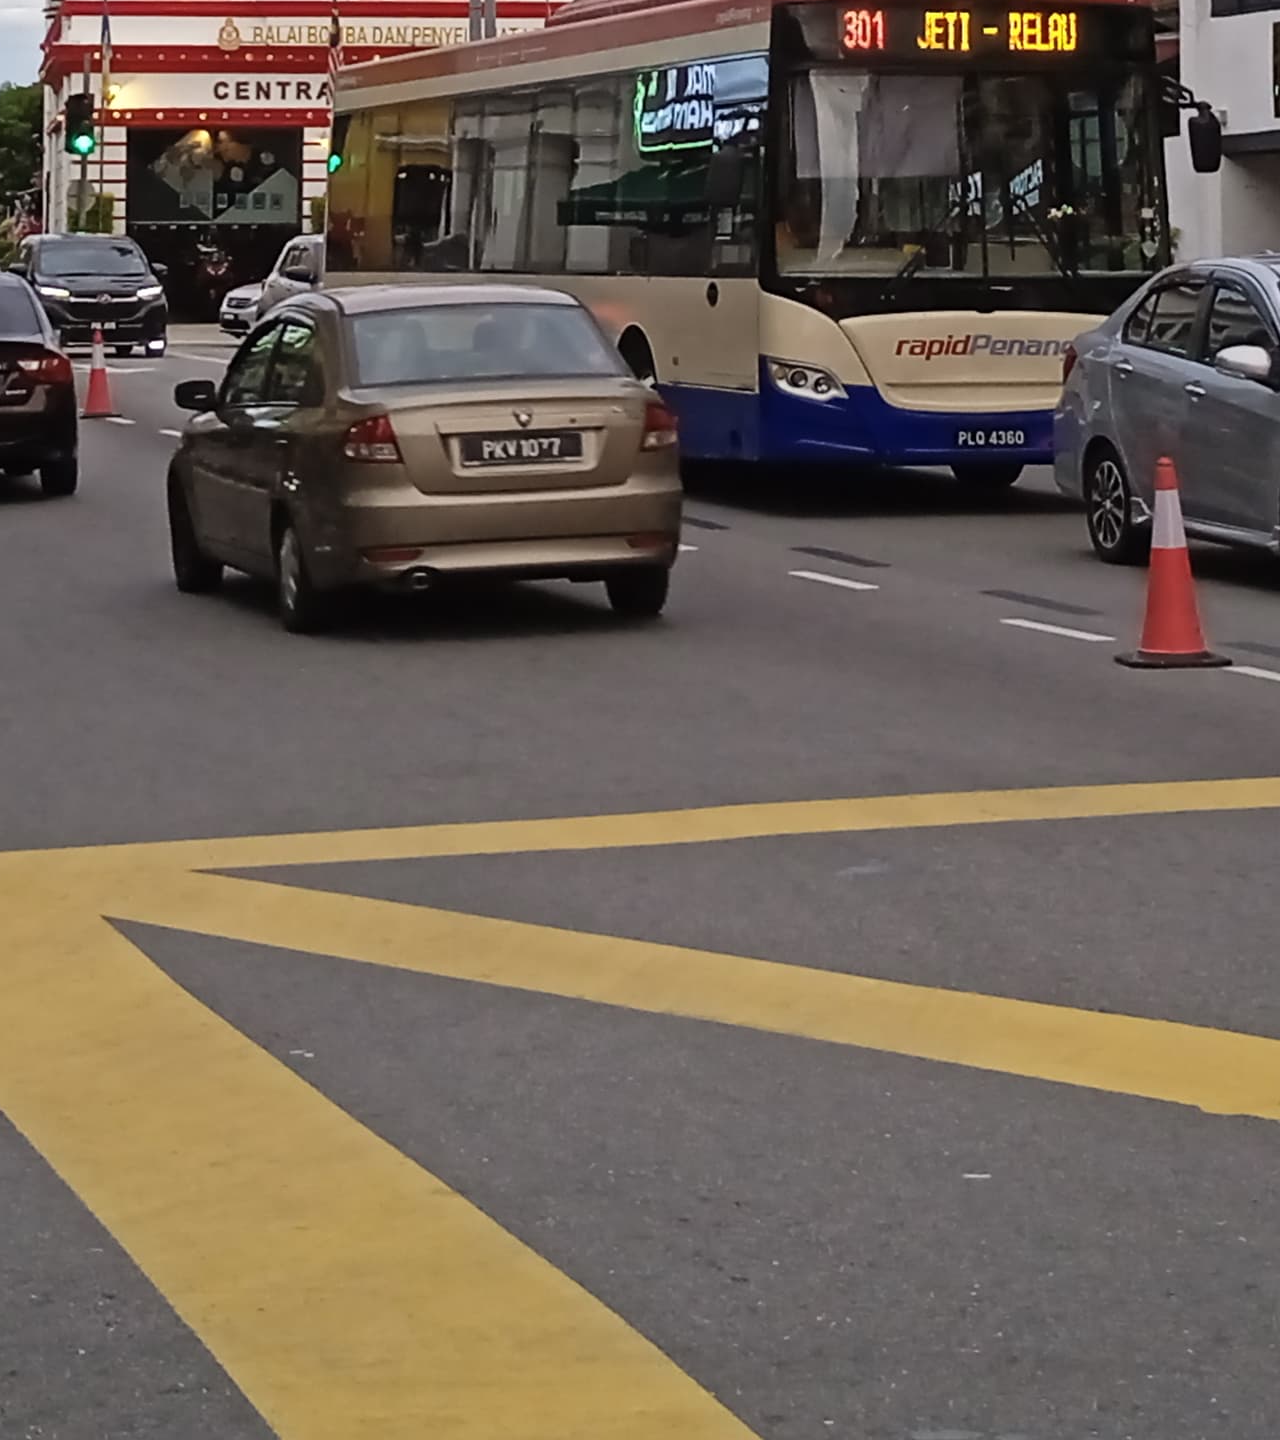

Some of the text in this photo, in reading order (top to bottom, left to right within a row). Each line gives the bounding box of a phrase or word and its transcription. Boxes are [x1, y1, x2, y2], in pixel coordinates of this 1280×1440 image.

[253, 25, 302, 44] BALAI
[307, 25, 368, 44] BOBA
[372, 25, 408, 44] DAN
[843, 10, 884, 49] 301
[917, 11, 970, 51] JETI
[1009, 12, 1076, 51] RELAU
[989, 430, 1025, 445] 4360
[482, 439, 518, 459] PKV
